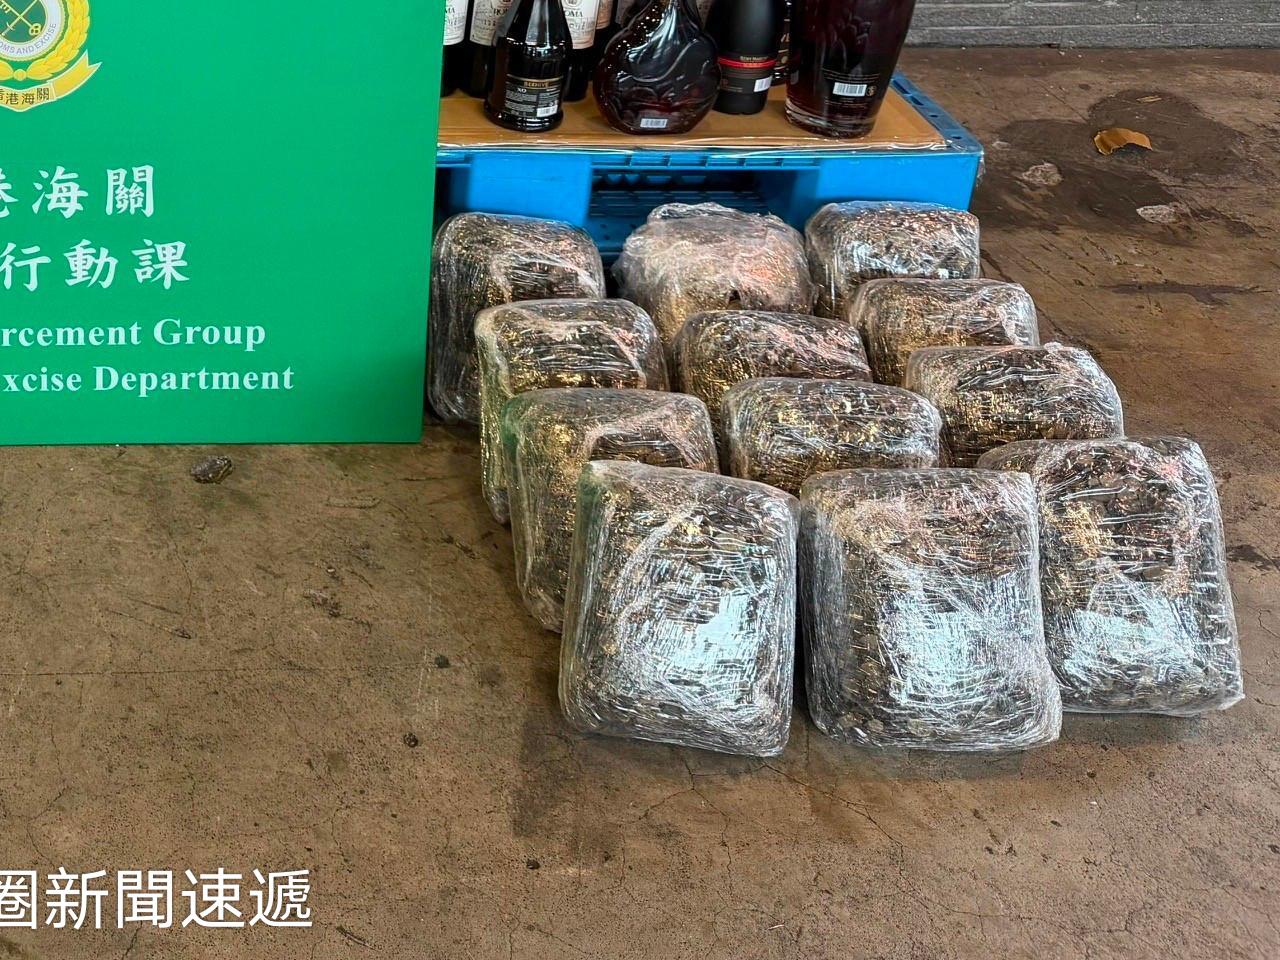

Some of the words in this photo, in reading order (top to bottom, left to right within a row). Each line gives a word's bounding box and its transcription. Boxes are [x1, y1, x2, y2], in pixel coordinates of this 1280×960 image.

[17, 46, 35, 55] AND
[34, 23, 57, 50] EXCISE
[153, 318, 266, 352] Group
[93, 365, 295, 398] Department
